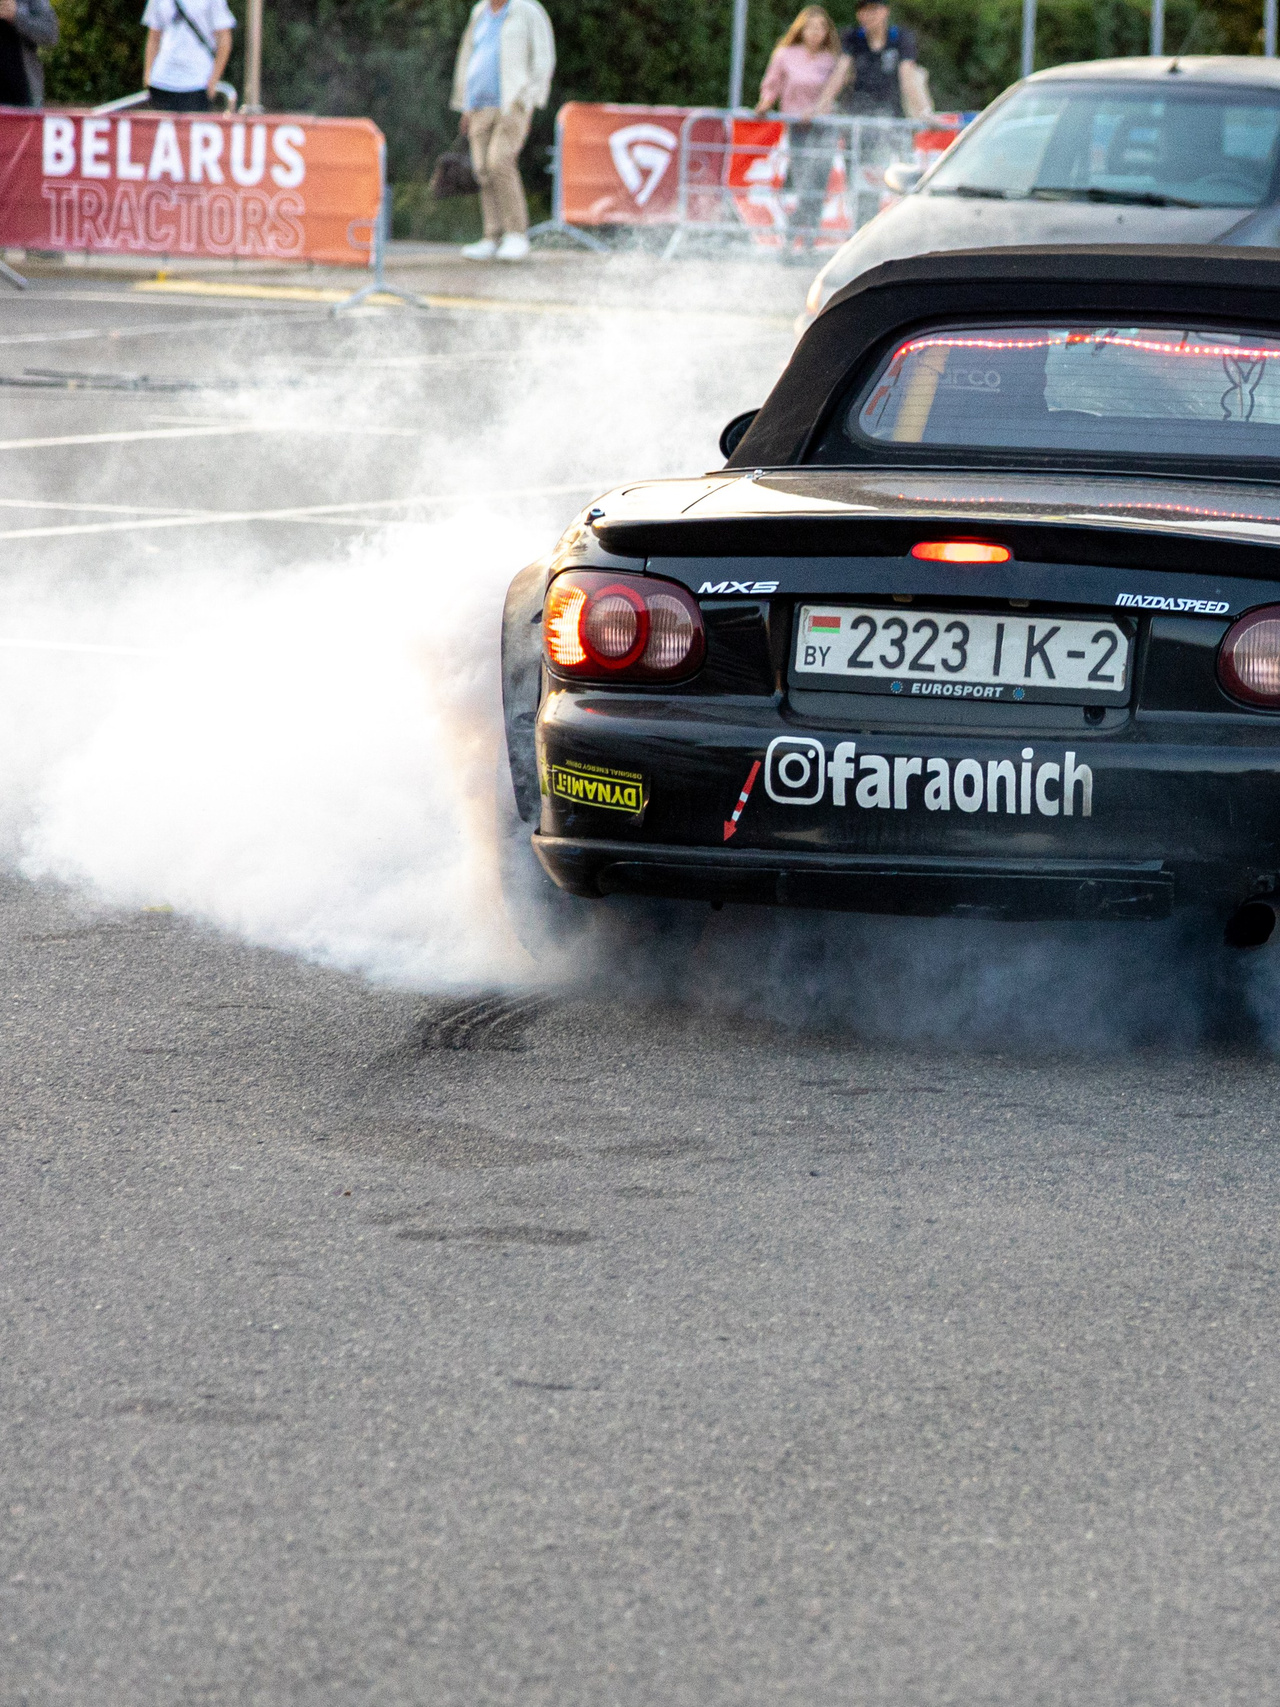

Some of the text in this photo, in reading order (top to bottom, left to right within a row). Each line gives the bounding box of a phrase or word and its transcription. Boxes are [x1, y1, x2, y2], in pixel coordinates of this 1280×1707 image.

[42, 115, 306, 188] BELARUS
[41, 179, 305, 256] TRACTORS
[1115, 593, 1230, 614] MAZDASPEED
[847, 615, 970, 674] 2323
[803, 645, 832, 667] BY
[911, 682, 1004, 699] EUROSPORT
[583, 763, 609, 774] ENERGY
[610, 768, 642, 780] ORIGINAL
